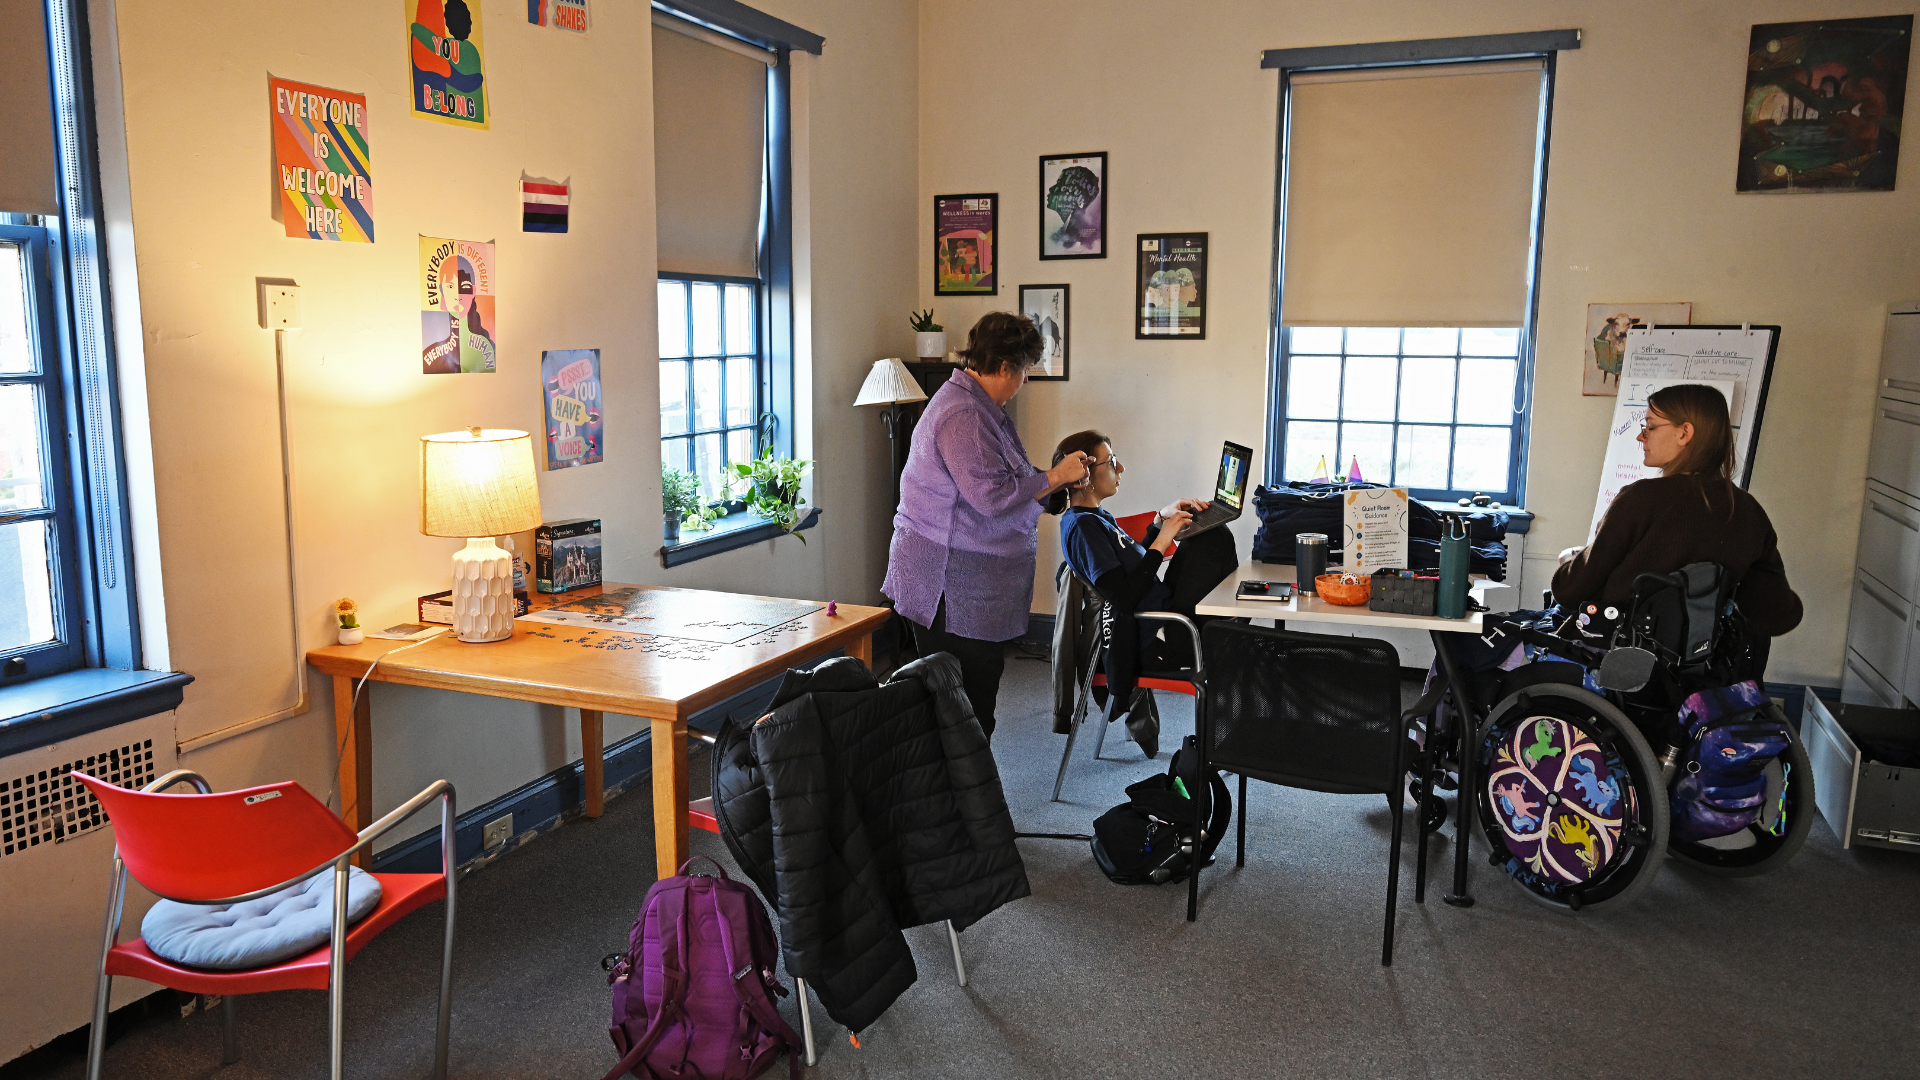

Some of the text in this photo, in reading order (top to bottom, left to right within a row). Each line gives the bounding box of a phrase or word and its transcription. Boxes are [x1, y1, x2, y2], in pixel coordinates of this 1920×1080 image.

[555, 4, 586, 31] SHAKES
[432, 36, 460, 65] YOU
[276, 87, 362, 128] EVERYONE
[423, 84, 475, 119] BELONG
[313, 132, 330, 159] IS
[281, 164, 364, 200] WELCOME
[304, 204, 343, 234] HERE
[428, 241, 489, 306] EVERYBODY IS DIFFERENT
[1149, 253, 1197, 265] Mental Health
[424, 319, 460, 366] EVERYBODY IS
[468, 334, 494, 369] HUMAN
[572, 382, 596, 401] YOU
[555, 398, 581, 422] HAVE
[564, 422, 572, 436] A
[558, 440, 582, 456] VOICE
